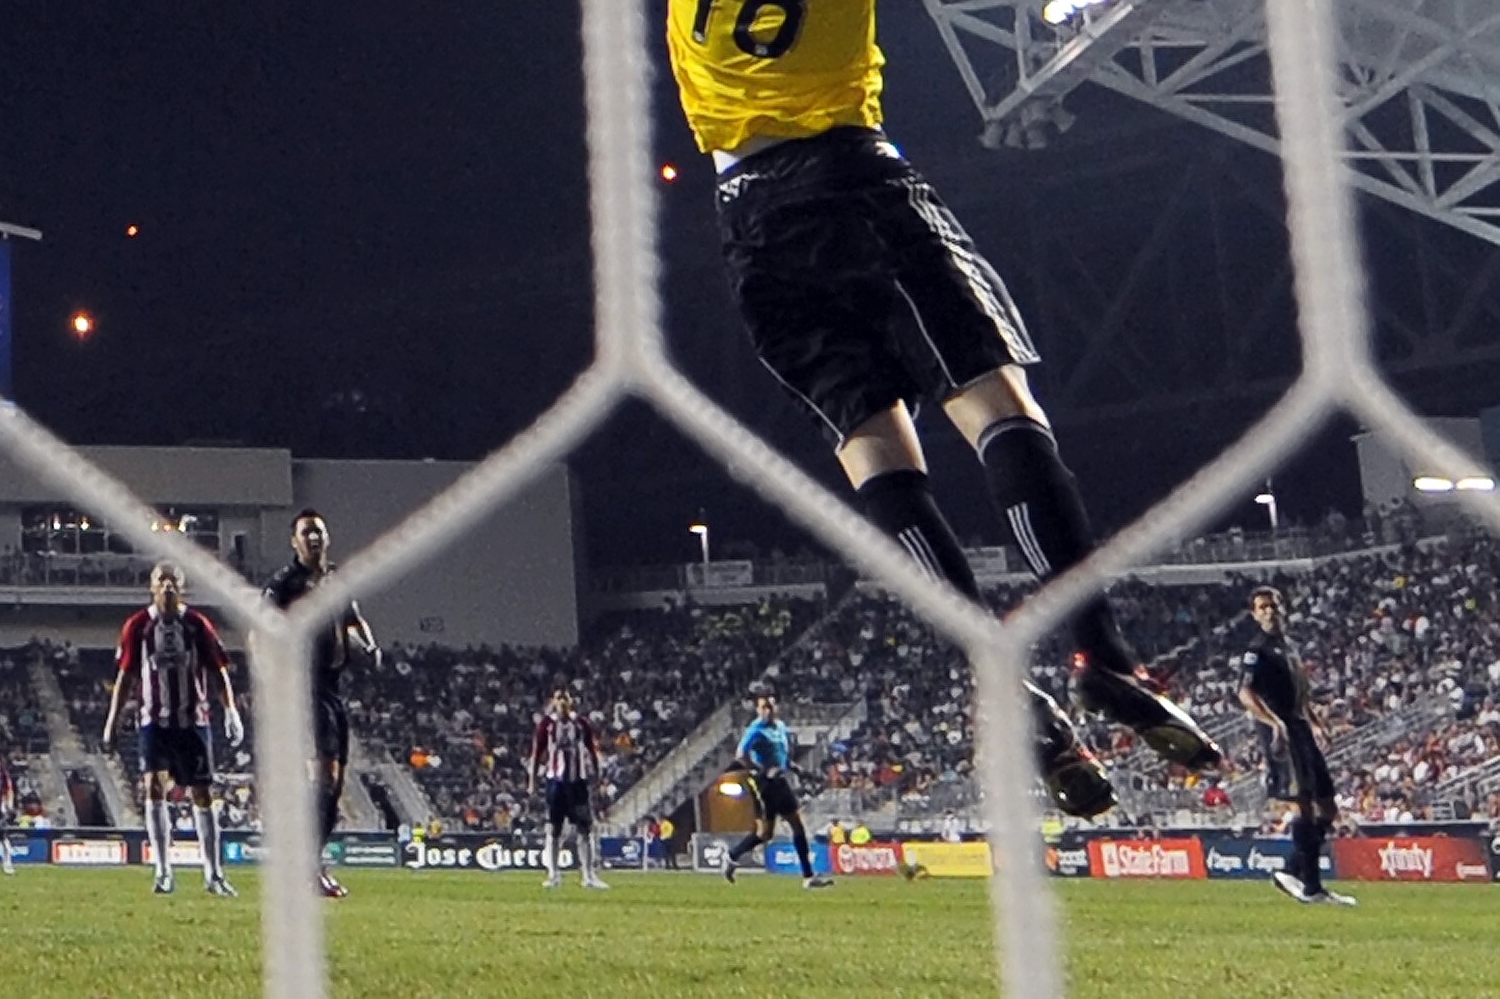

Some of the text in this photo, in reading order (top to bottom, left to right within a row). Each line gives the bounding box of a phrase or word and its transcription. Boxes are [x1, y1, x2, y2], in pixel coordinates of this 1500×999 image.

[405, 841, 471, 869] Jose
[475, 842, 574, 870] Cuero
[1378, 841, 1433, 878] xfinity
